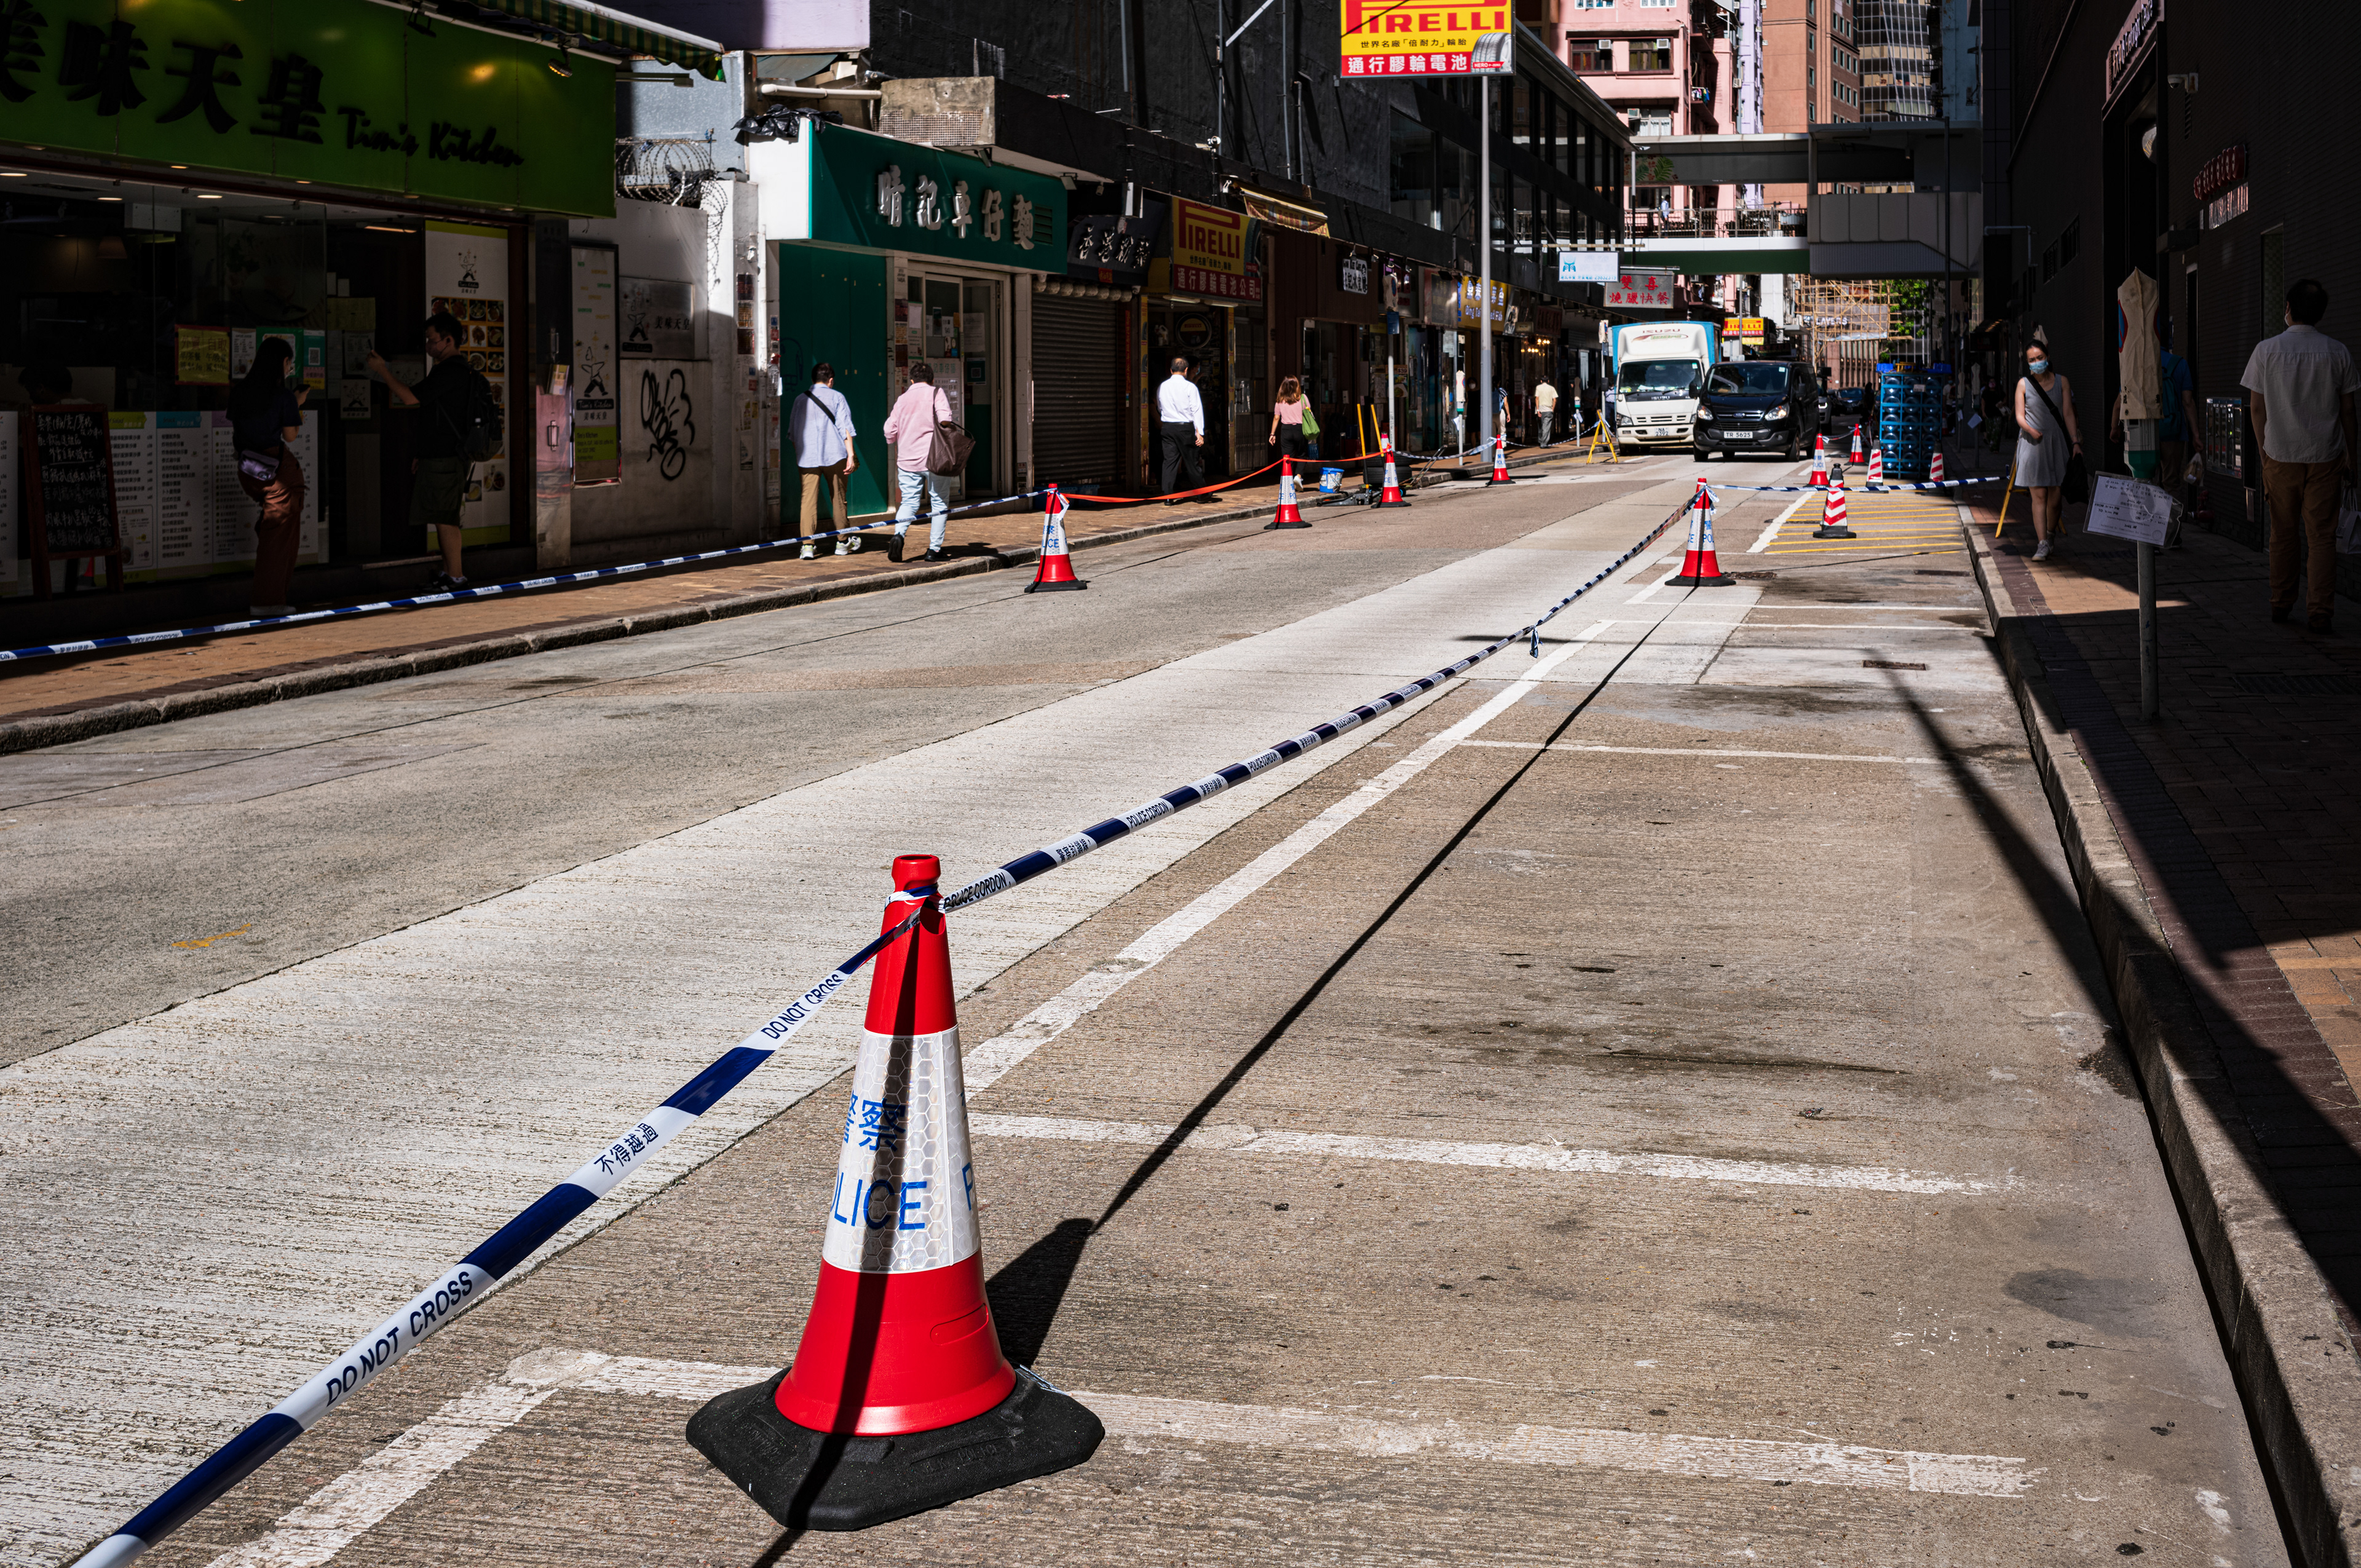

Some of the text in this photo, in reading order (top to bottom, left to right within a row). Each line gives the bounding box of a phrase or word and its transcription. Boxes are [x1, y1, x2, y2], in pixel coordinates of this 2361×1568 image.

[1346, 0, 1507, 34] PIRELLI
[1348, 55, 1468, 73] 通行膠輪電池
[339, 108, 524, 167] Tim's Kitchen
[1179, 199, 1240, 259] PIRELLI
[1177, 267, 1256, 299] 通行膠輪電池公司
[1620, 275, 1659, 290] 雙喜
[655, 315, 690, 330] 美味天皇
[208, 338, 226, 352] 自取
[135, 635, 154, 646] POLICE
[1248, 757, 1264, 774] POLICE
[1126, 811, 1148, 829] POLICE
[944, 884, 974, 911] POLICE
[761, 972, 847, 1040] DO NOT CROSS
[593, 1121, 660, 1177] 不得越過
[325, 1270, 475, 1408] DO NOT CROSS
[959, 1443, 999, 1464] POLICE
